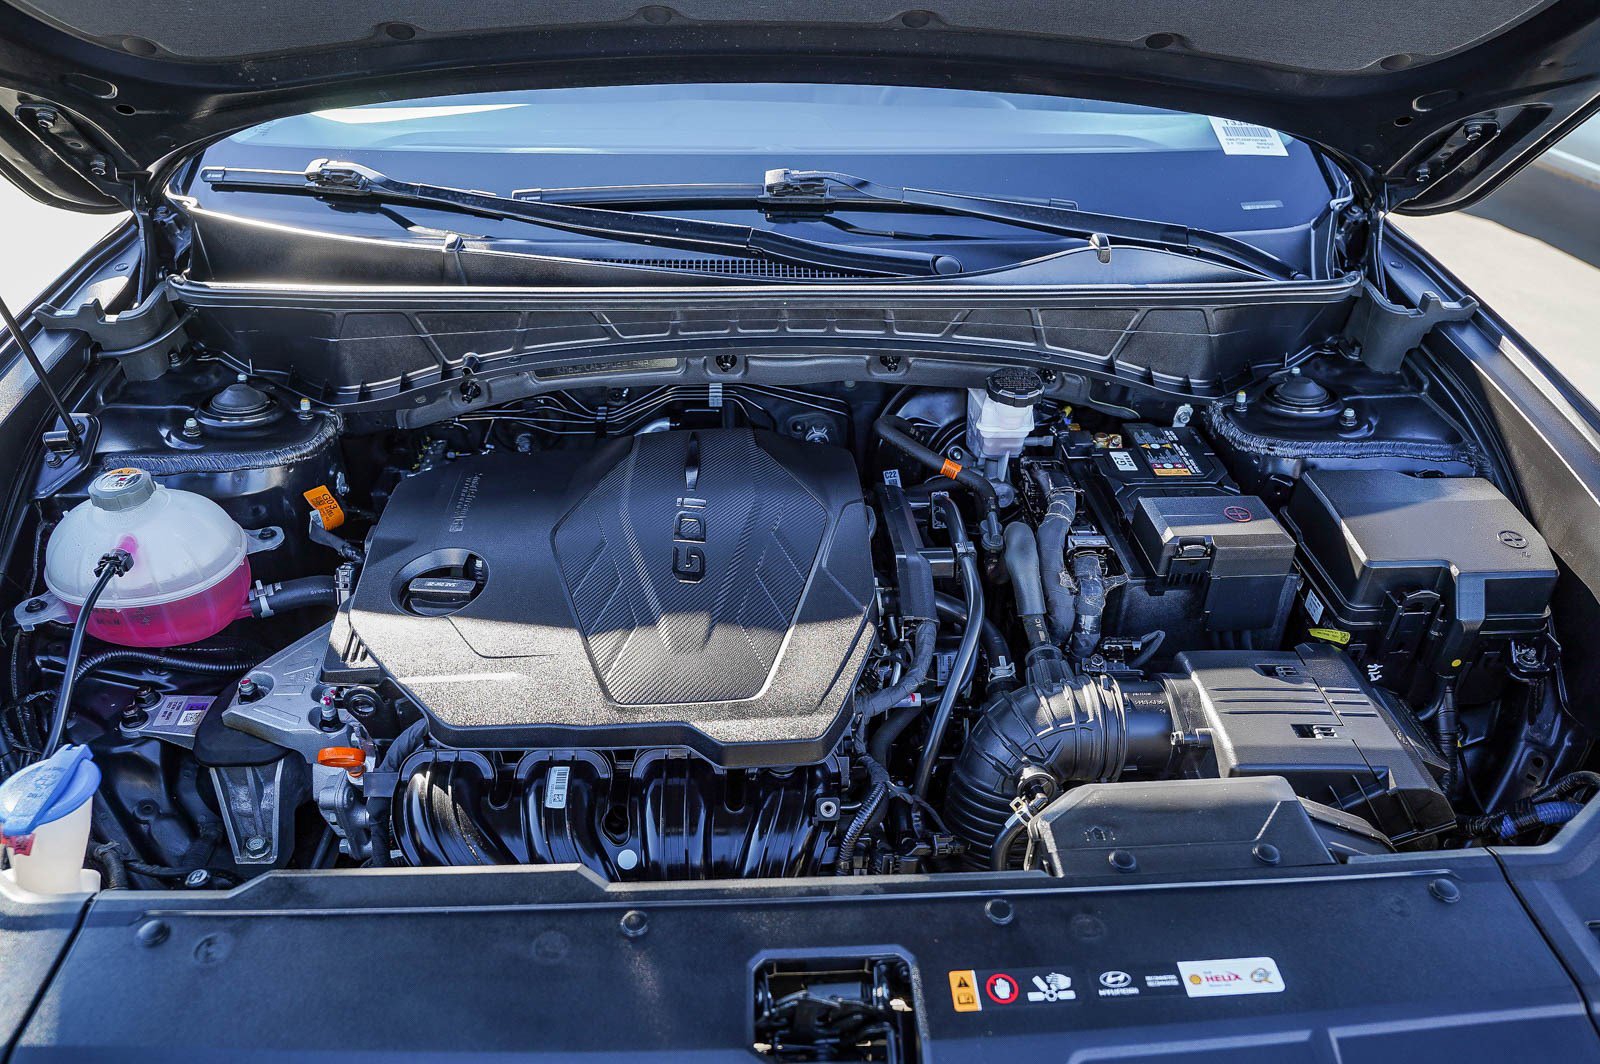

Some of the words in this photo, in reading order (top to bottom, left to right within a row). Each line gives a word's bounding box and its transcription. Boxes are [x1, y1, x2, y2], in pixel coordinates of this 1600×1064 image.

[884, 470, 897, 479] C22
[321, 493, 338, 510] G03
[671, 497, 707, 583] GDi
[1205, 971, 1243, 983] HELIX
